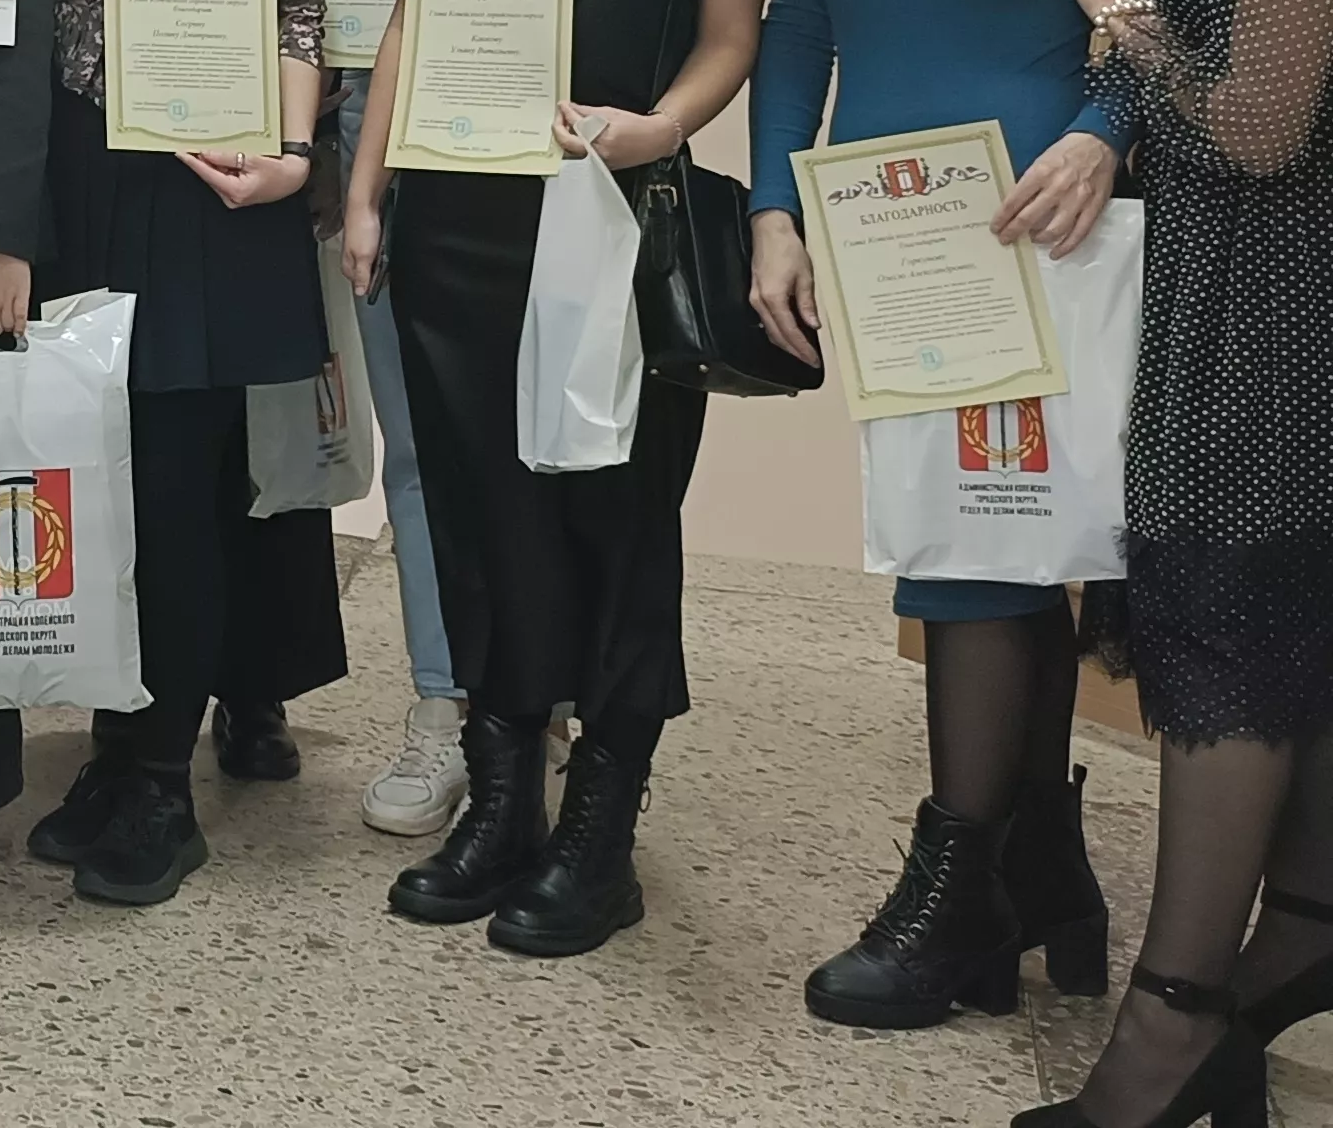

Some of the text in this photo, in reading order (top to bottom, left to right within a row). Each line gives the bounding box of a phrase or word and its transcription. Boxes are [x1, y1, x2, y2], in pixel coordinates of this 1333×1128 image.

[860, 199, 968, 225] БЛАГОДАРНОСТЬ
[30, 614, 75, 626] КОПЕЙСКОГО
[30, 630, 57, 641] ОКРУГА
[2, 645, 30, 656] ДЕЛАМ
[32, 643, 75, 655] МОЛОДЕЖИ
